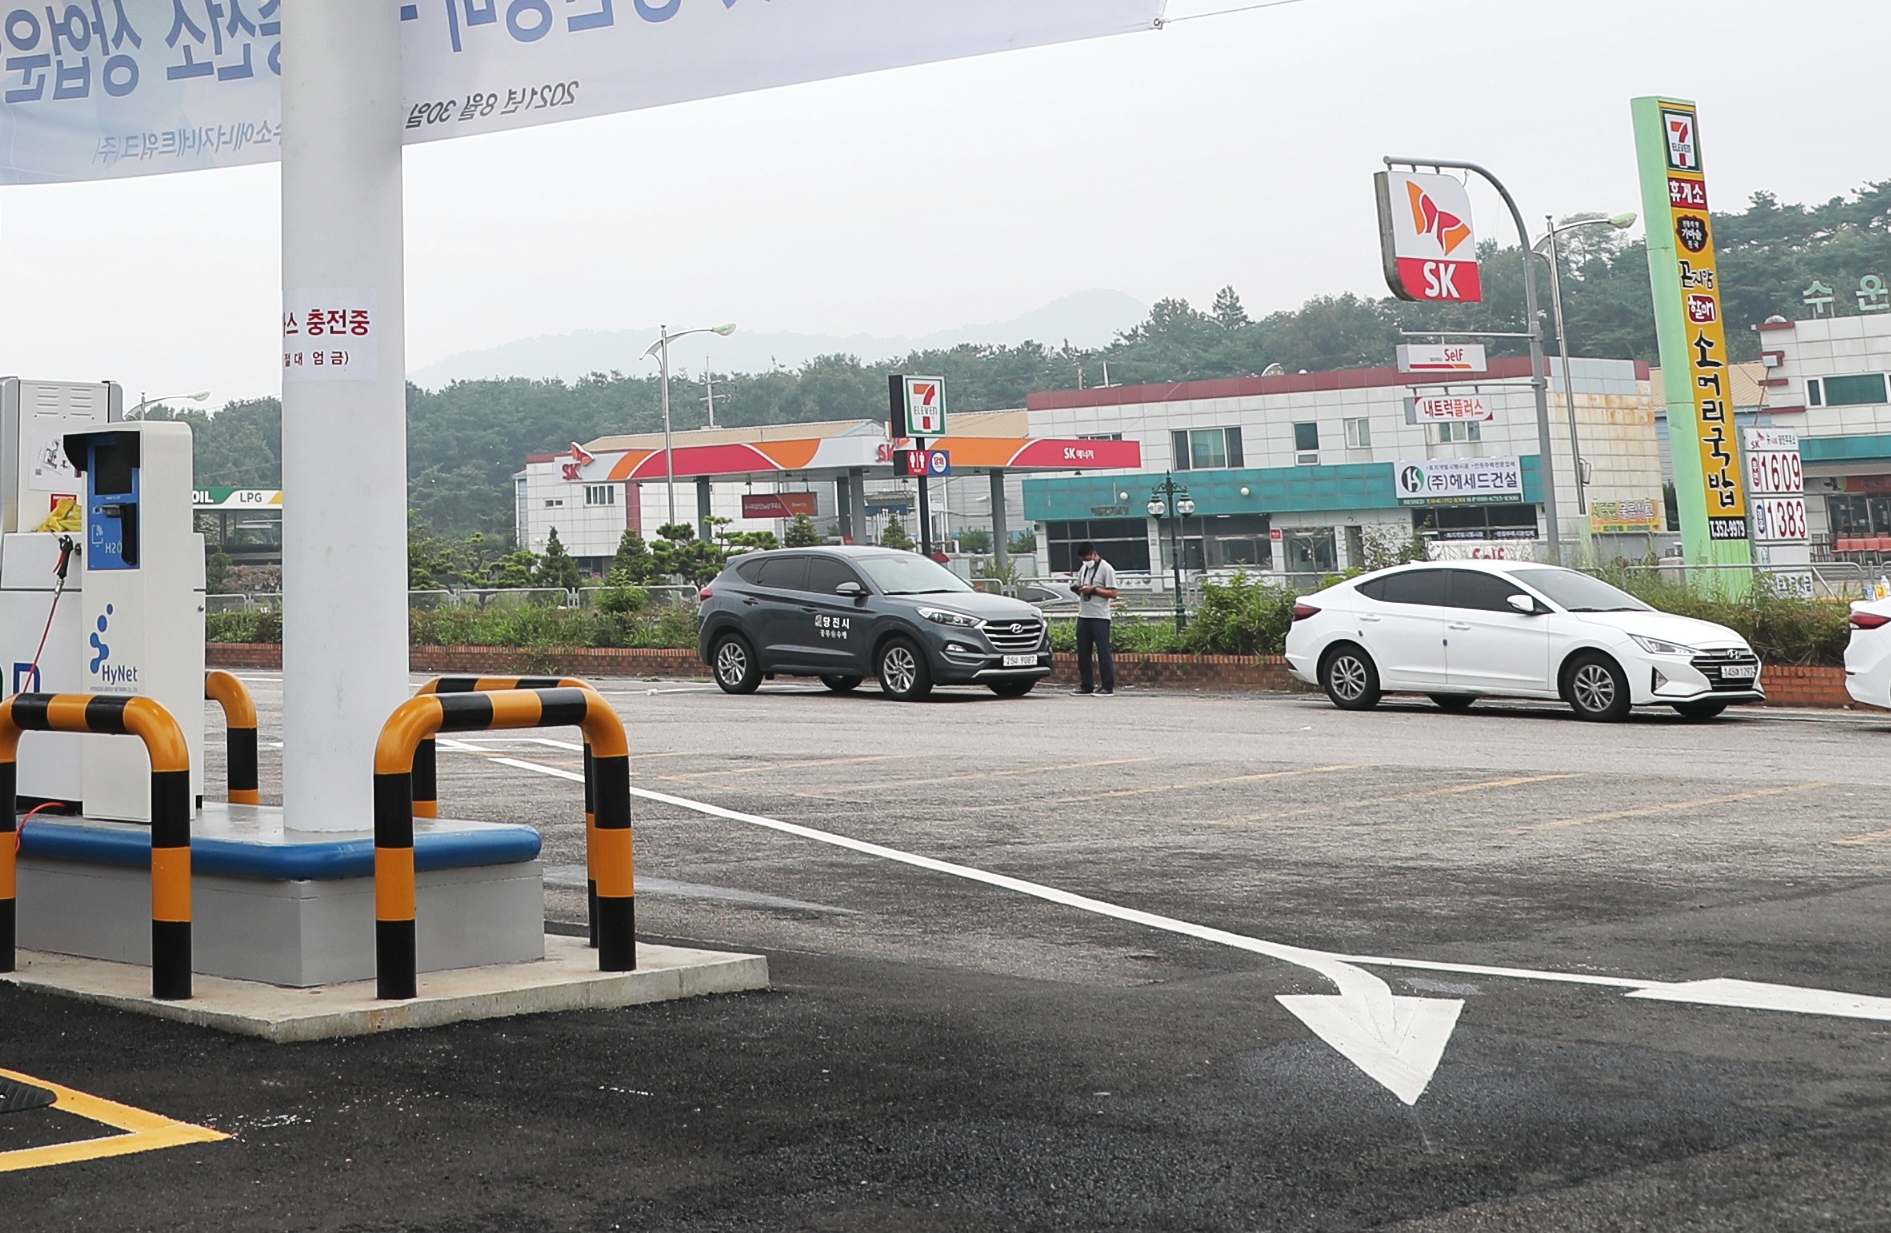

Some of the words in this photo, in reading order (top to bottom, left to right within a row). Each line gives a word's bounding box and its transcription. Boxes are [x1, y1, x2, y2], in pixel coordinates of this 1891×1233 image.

[1669, 180, 1705, 204] 휴게소
[1423, 261, 1460, 298] SK
[1679, 260, 1714, 289] 곤지암
[1687, 296, 1714, 320] 할매
[307, 309, 370, 336] 충전중
[1444, 348, 1463, 362] Self
[1423, 398, 1484, 418] 내트럭플러스
[1693, 328, 1738, 509] 소머리국밥
[876, 443, 894, 462] SK
[1064, 447, 1076, 459] SK
[562, 463, 582, 481] SK
[1427, 471, 1517, 491] (주)헤세드건설
[1761, 454, 1801, 491] 1609
[240, 492, 262, 503] LPG
[1767, 501, 1806, 539] 1383
[102, 665, 138, 686] HyNet
